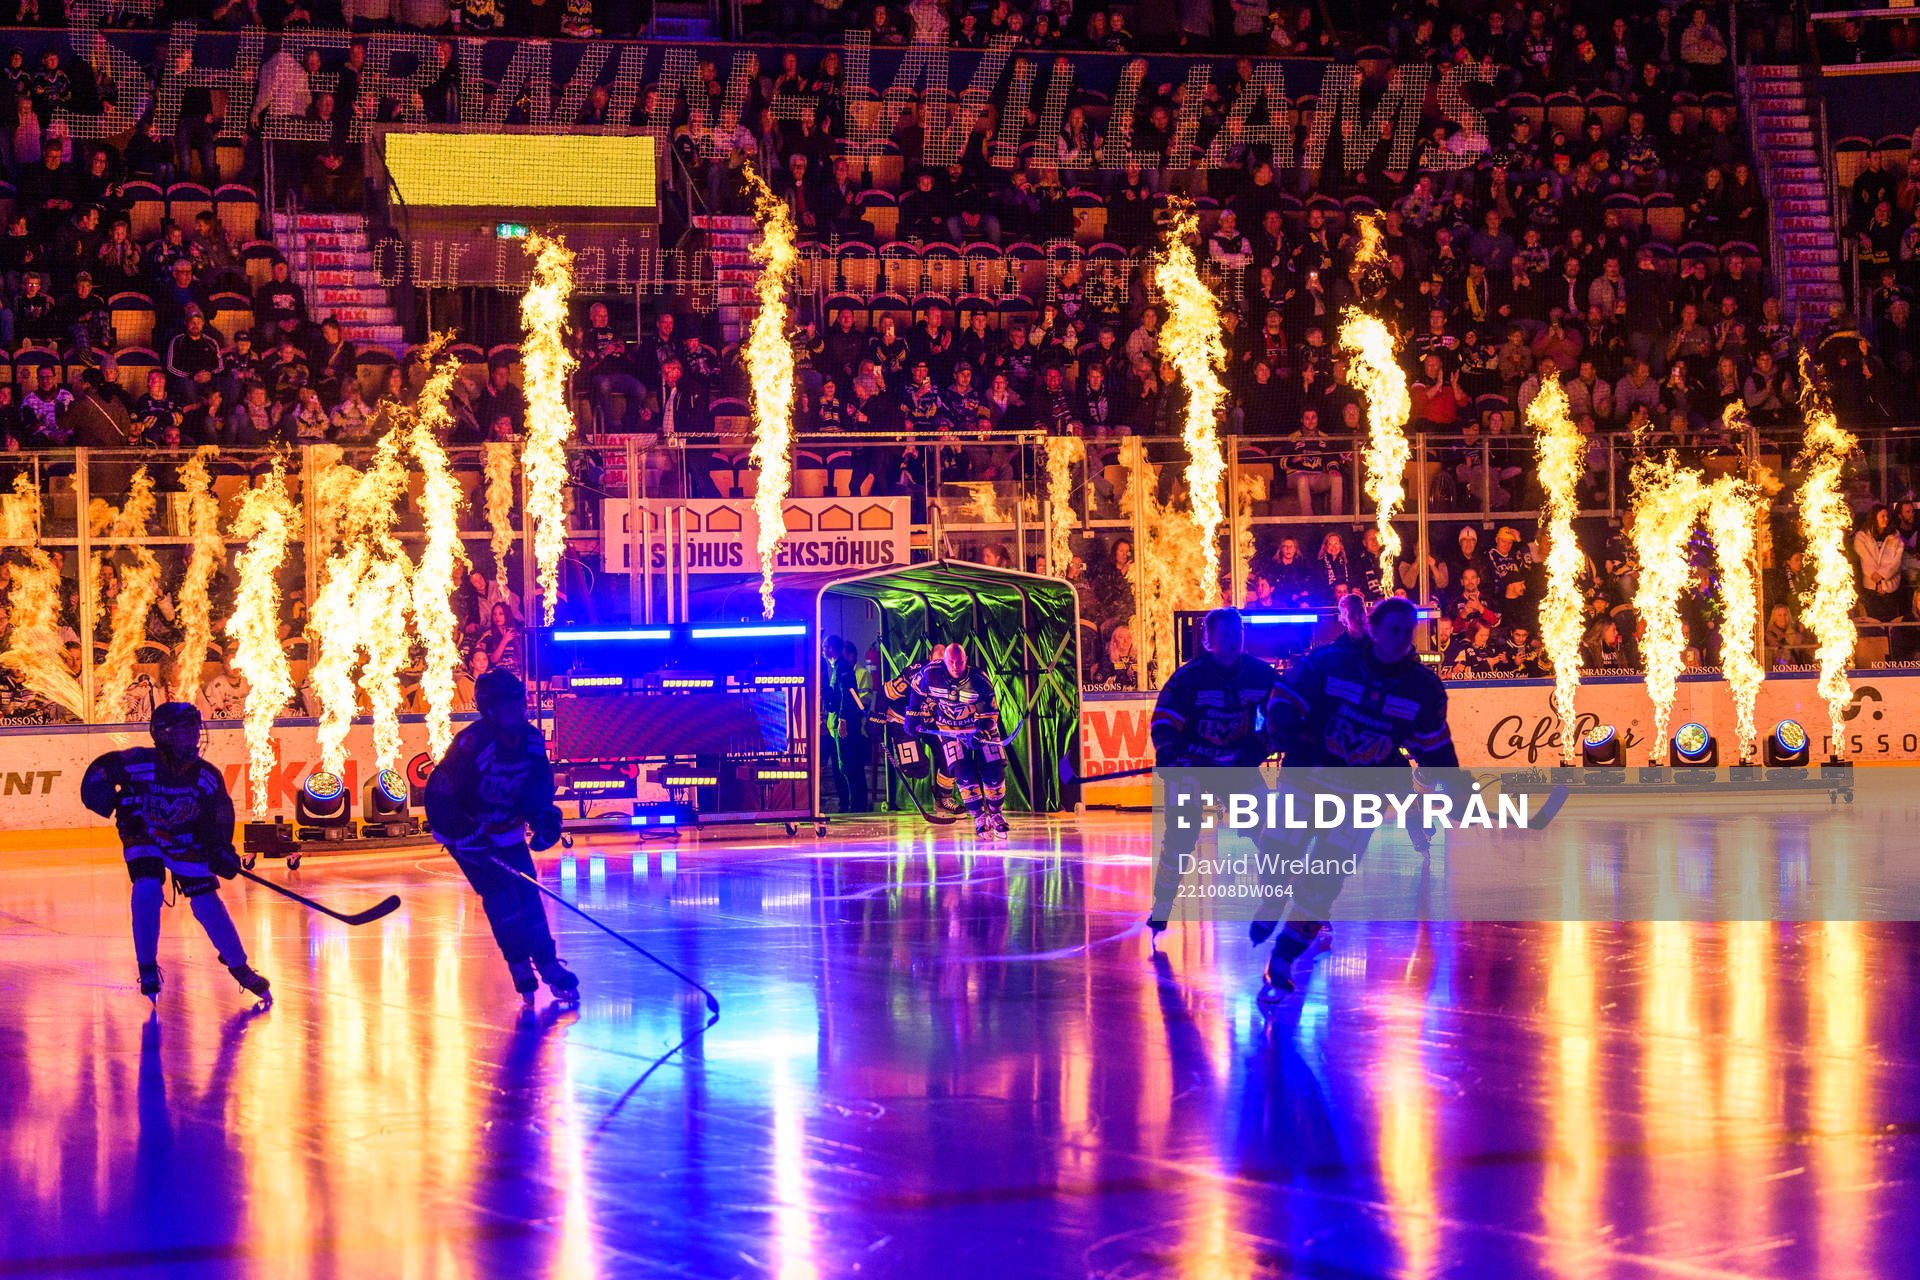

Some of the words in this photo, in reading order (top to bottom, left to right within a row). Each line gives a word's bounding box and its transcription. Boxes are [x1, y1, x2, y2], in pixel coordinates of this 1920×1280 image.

[47, 0, 1500, 171] SHERWIN-WILLIAMS
[1047, 236, 1254, 304] Parter
[777, 536, 895, 567] EKSJÖHUS
[1082, 683, 1122, 692] ADSSONS
[1452, 671, 1514, 680] KONRADSSONS
[0, 770, 62, 796] NT
